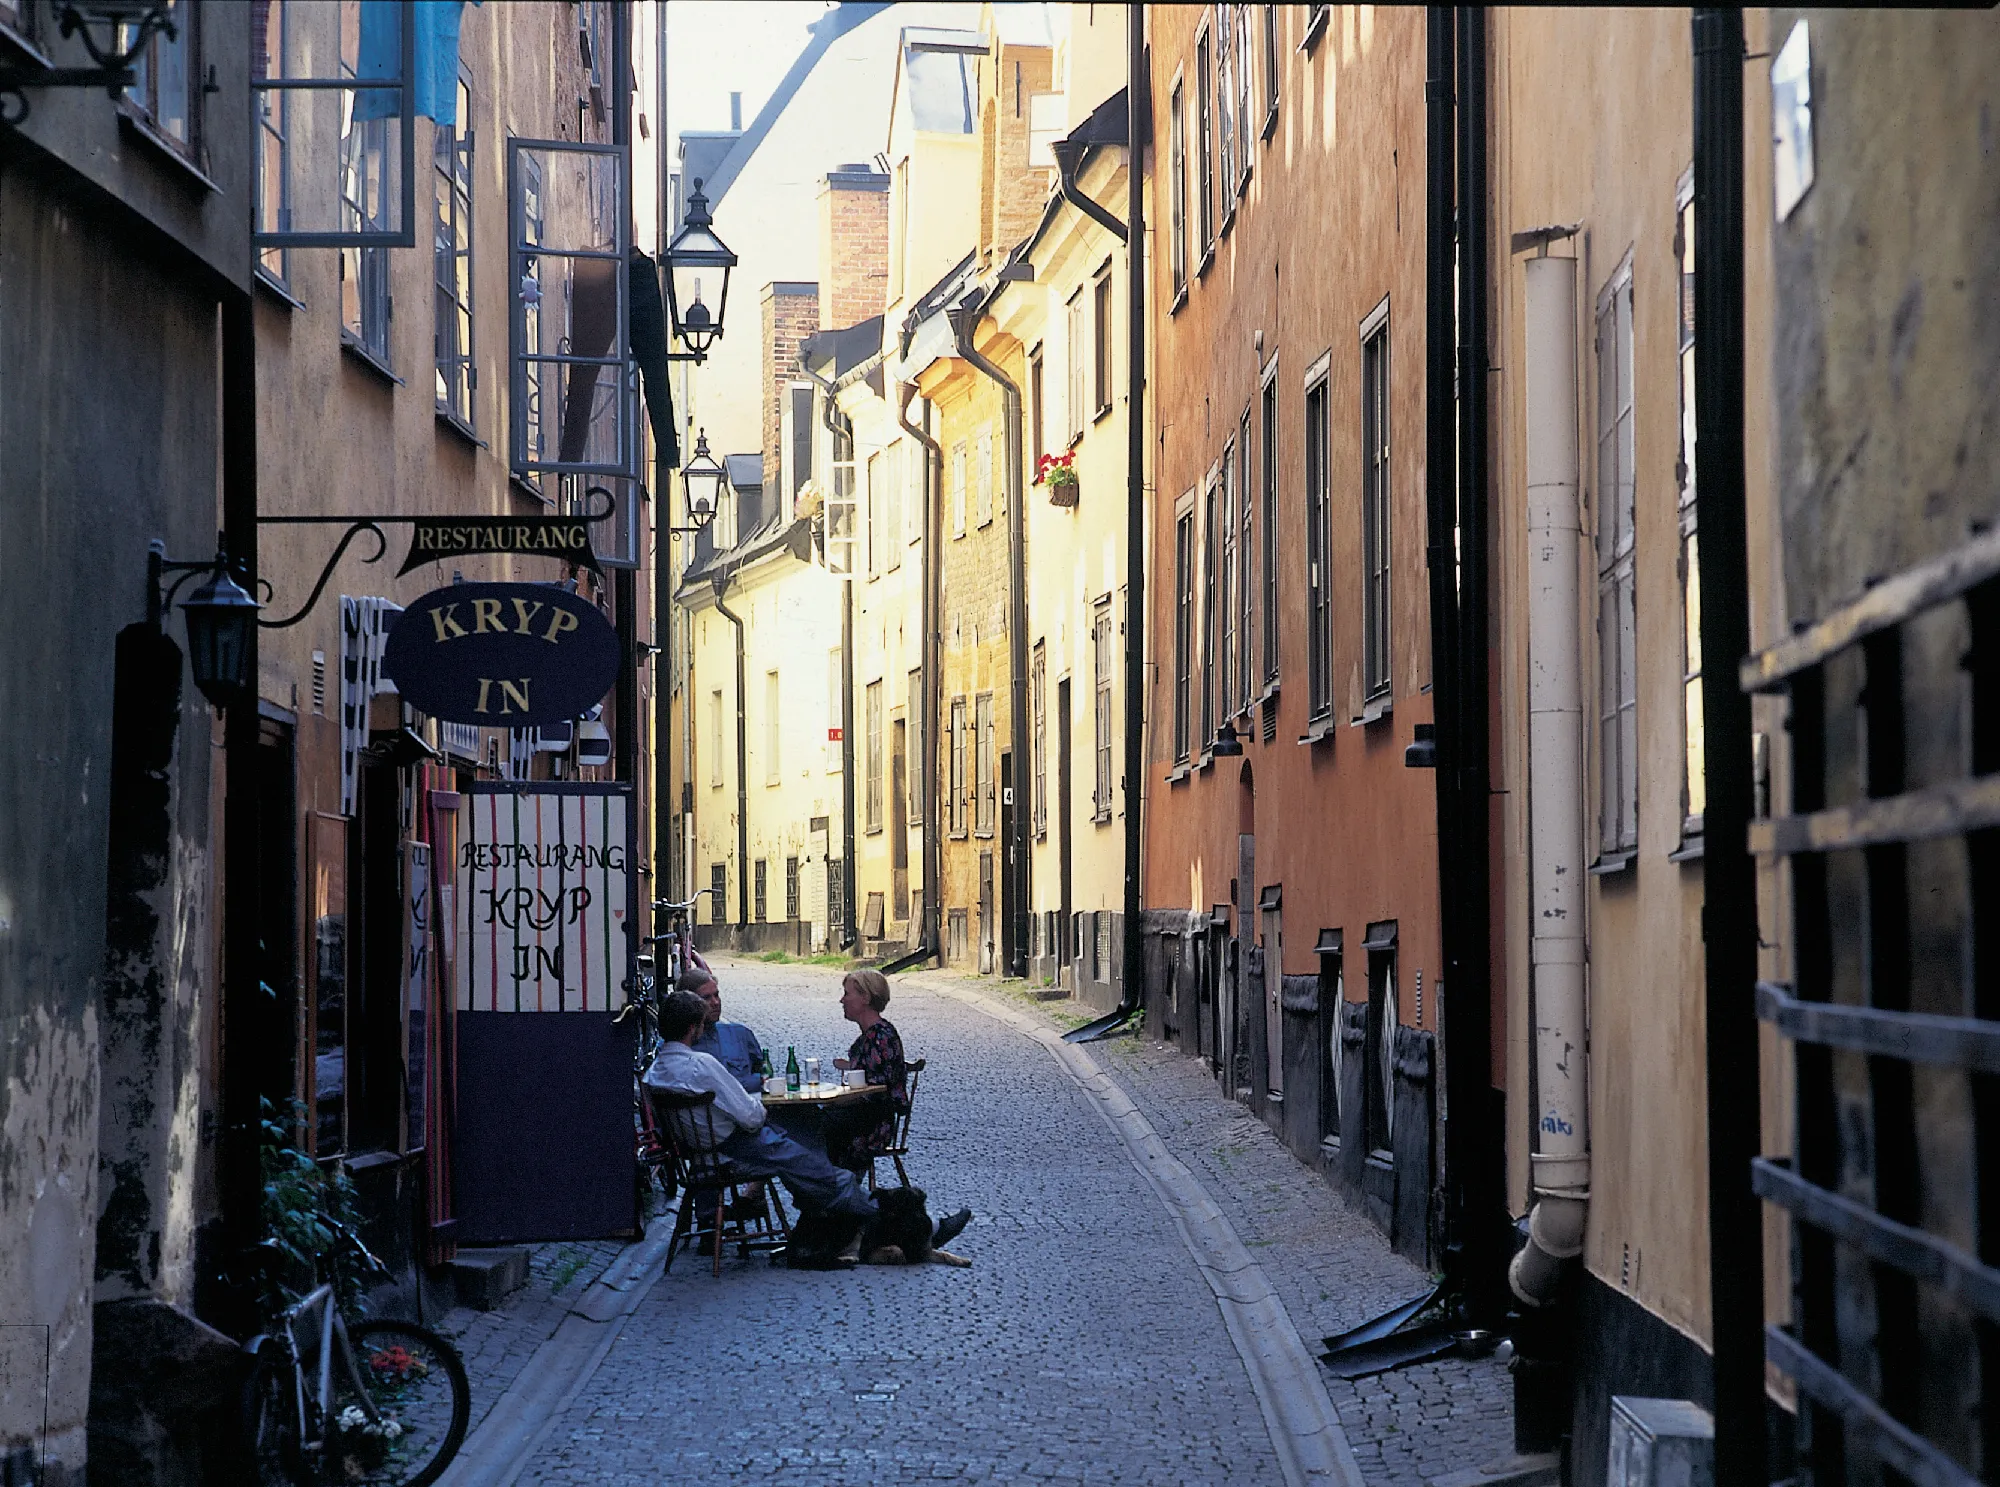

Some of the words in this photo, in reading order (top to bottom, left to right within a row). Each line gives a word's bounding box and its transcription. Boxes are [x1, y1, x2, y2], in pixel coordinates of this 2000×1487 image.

[418, 525, 587, 550] RESTAURANG
[428, 597, 580, 645] KRYP
[473, 677, 532, 715] IN
[1006, 790, 1012, 802] 4
[461, 843, 628, 875] RESTAURANG
[479, 886, 592, 931] KRYP
